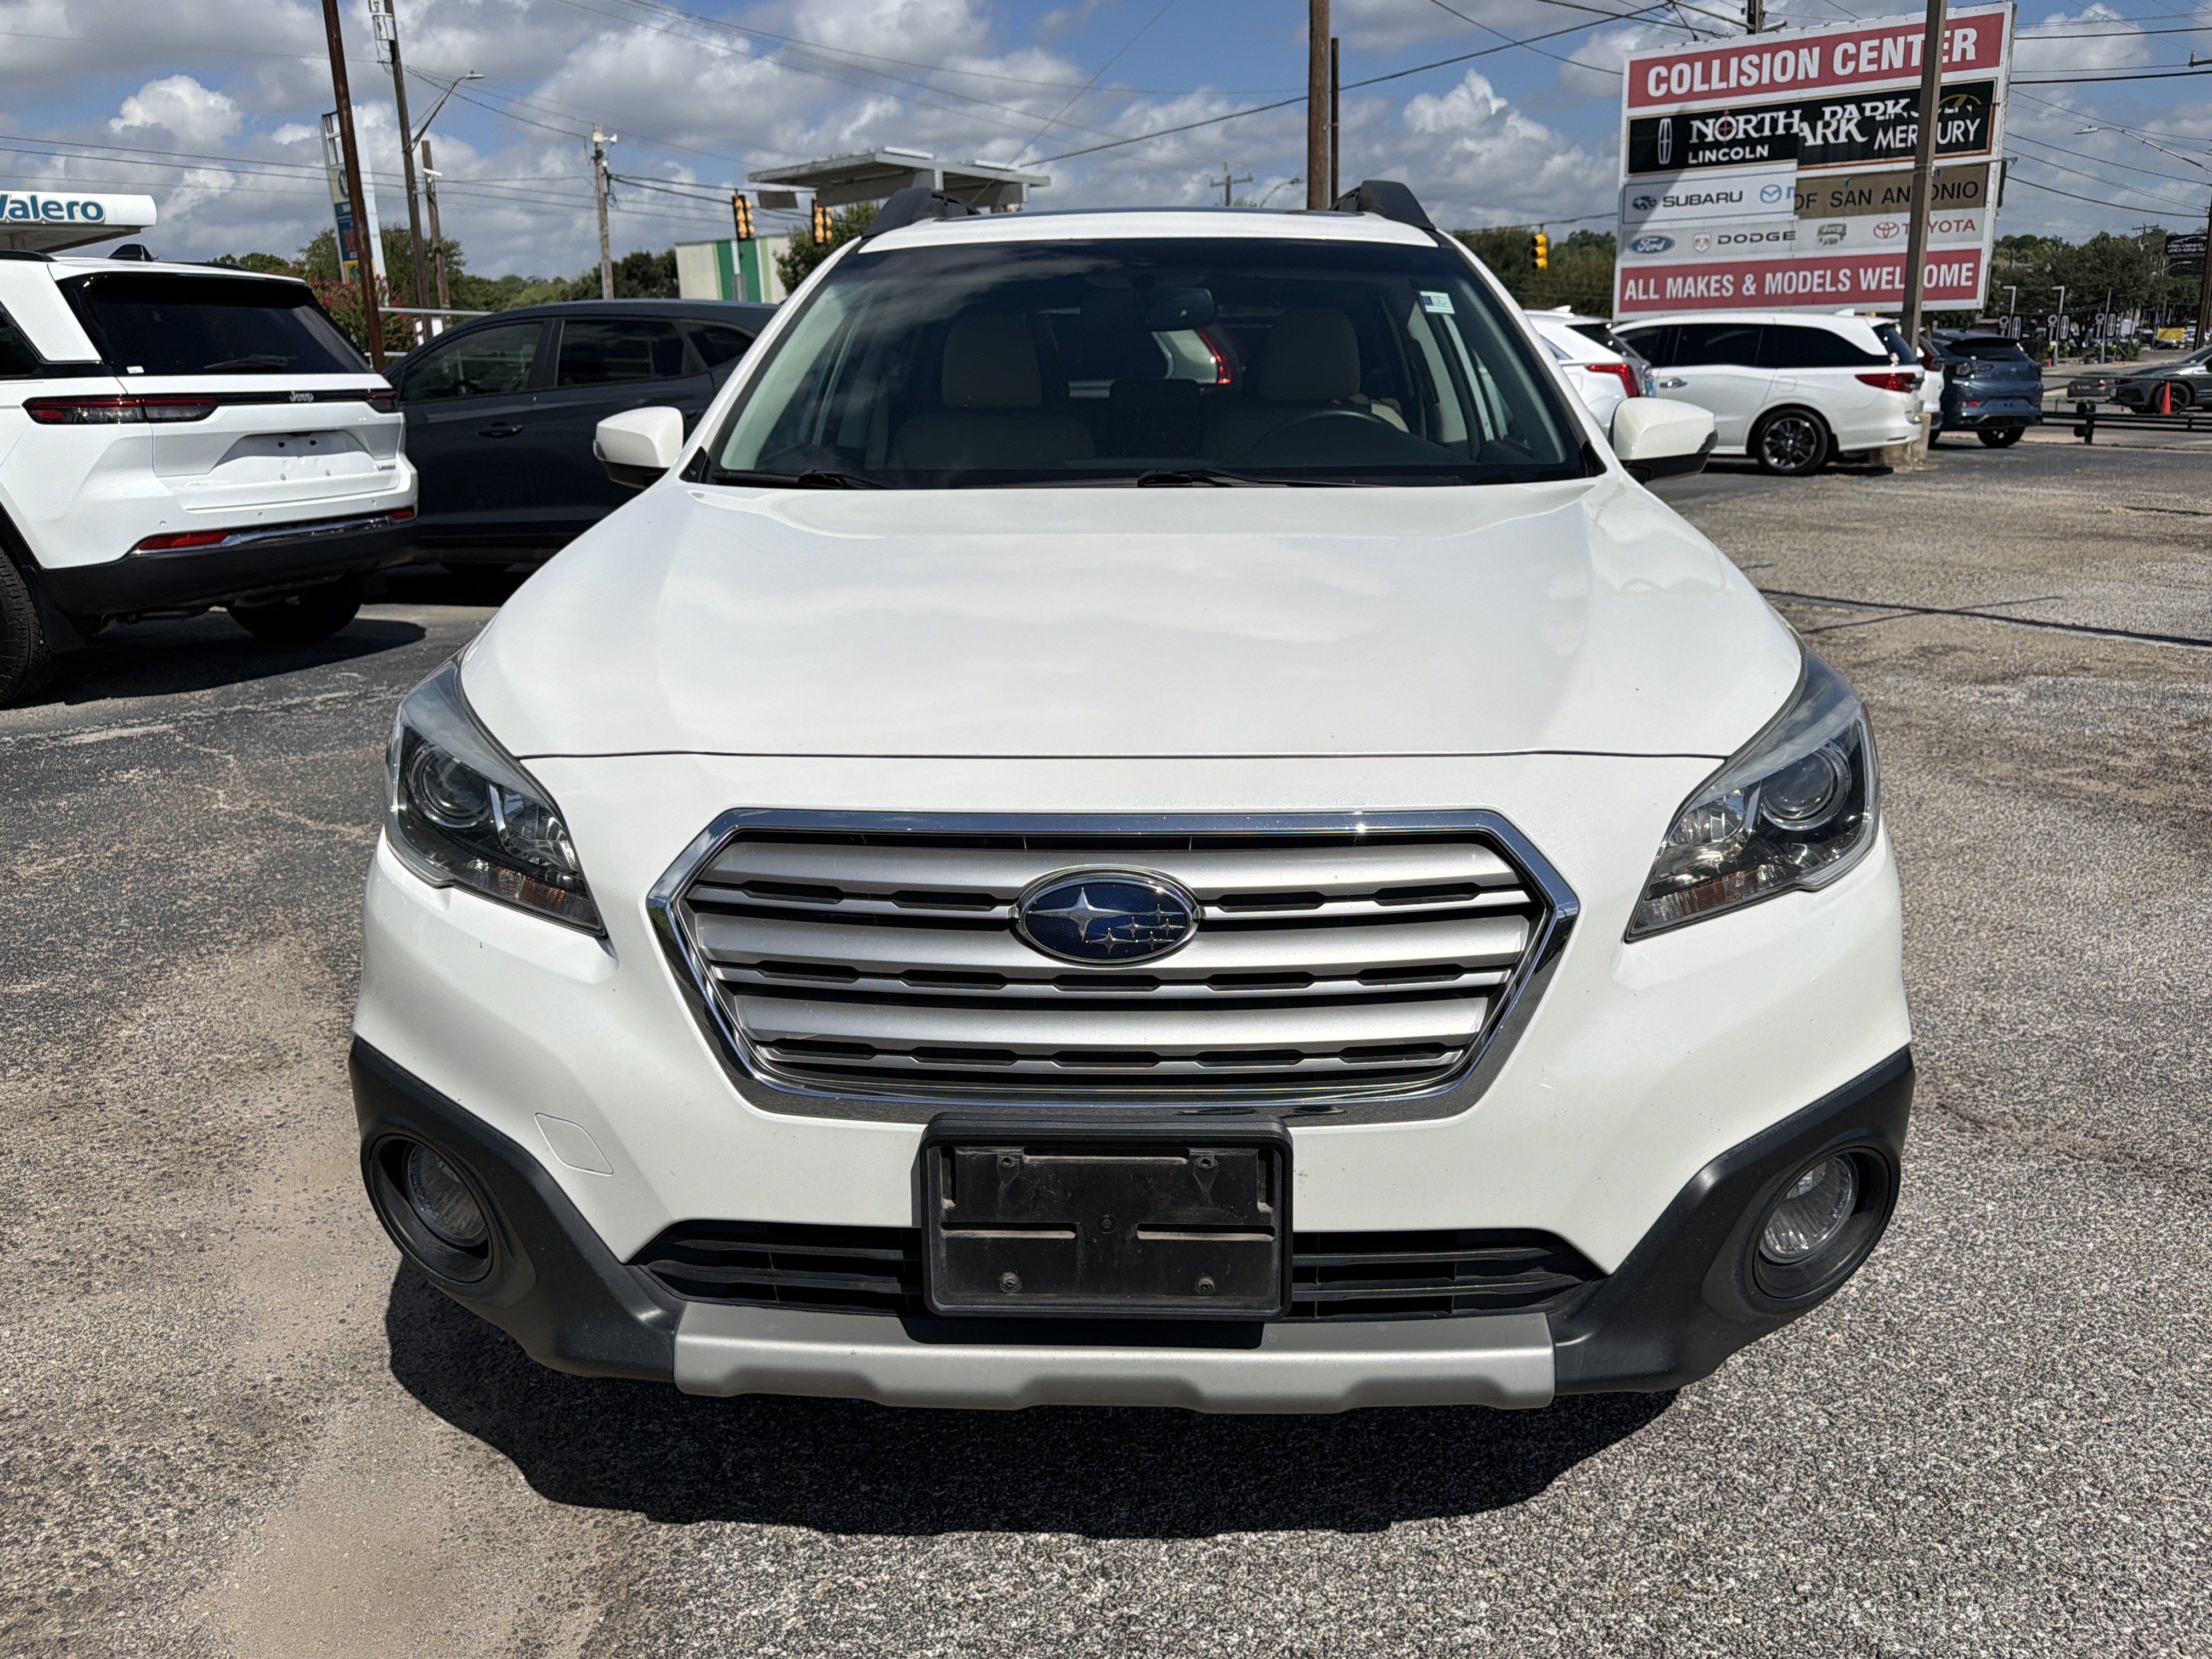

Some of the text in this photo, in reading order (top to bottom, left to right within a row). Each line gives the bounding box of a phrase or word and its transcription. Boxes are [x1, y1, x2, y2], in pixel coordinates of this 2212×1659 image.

[1647, 47, 1820, 97] COLLISION
[1689, 109, 1802, 144] NORTH
[1874, 118, 1981, 150] MERURY
[1688, 144, 1769, 164] LINCOLN
[1663, 190, 1743, 207] SUBARU
[1795, 181, 1978, 211] OF SAN ANNIO
[1901, 219, 1976, 235] TYOTA
[1637, 237, 1666, 252] Ford
[1718, 230, 1797, 245] DODGE
[1624, 262, 1974, 301] ALL MAKES & MODELS WELOME
[289, 390, 314, 403] Jeep
